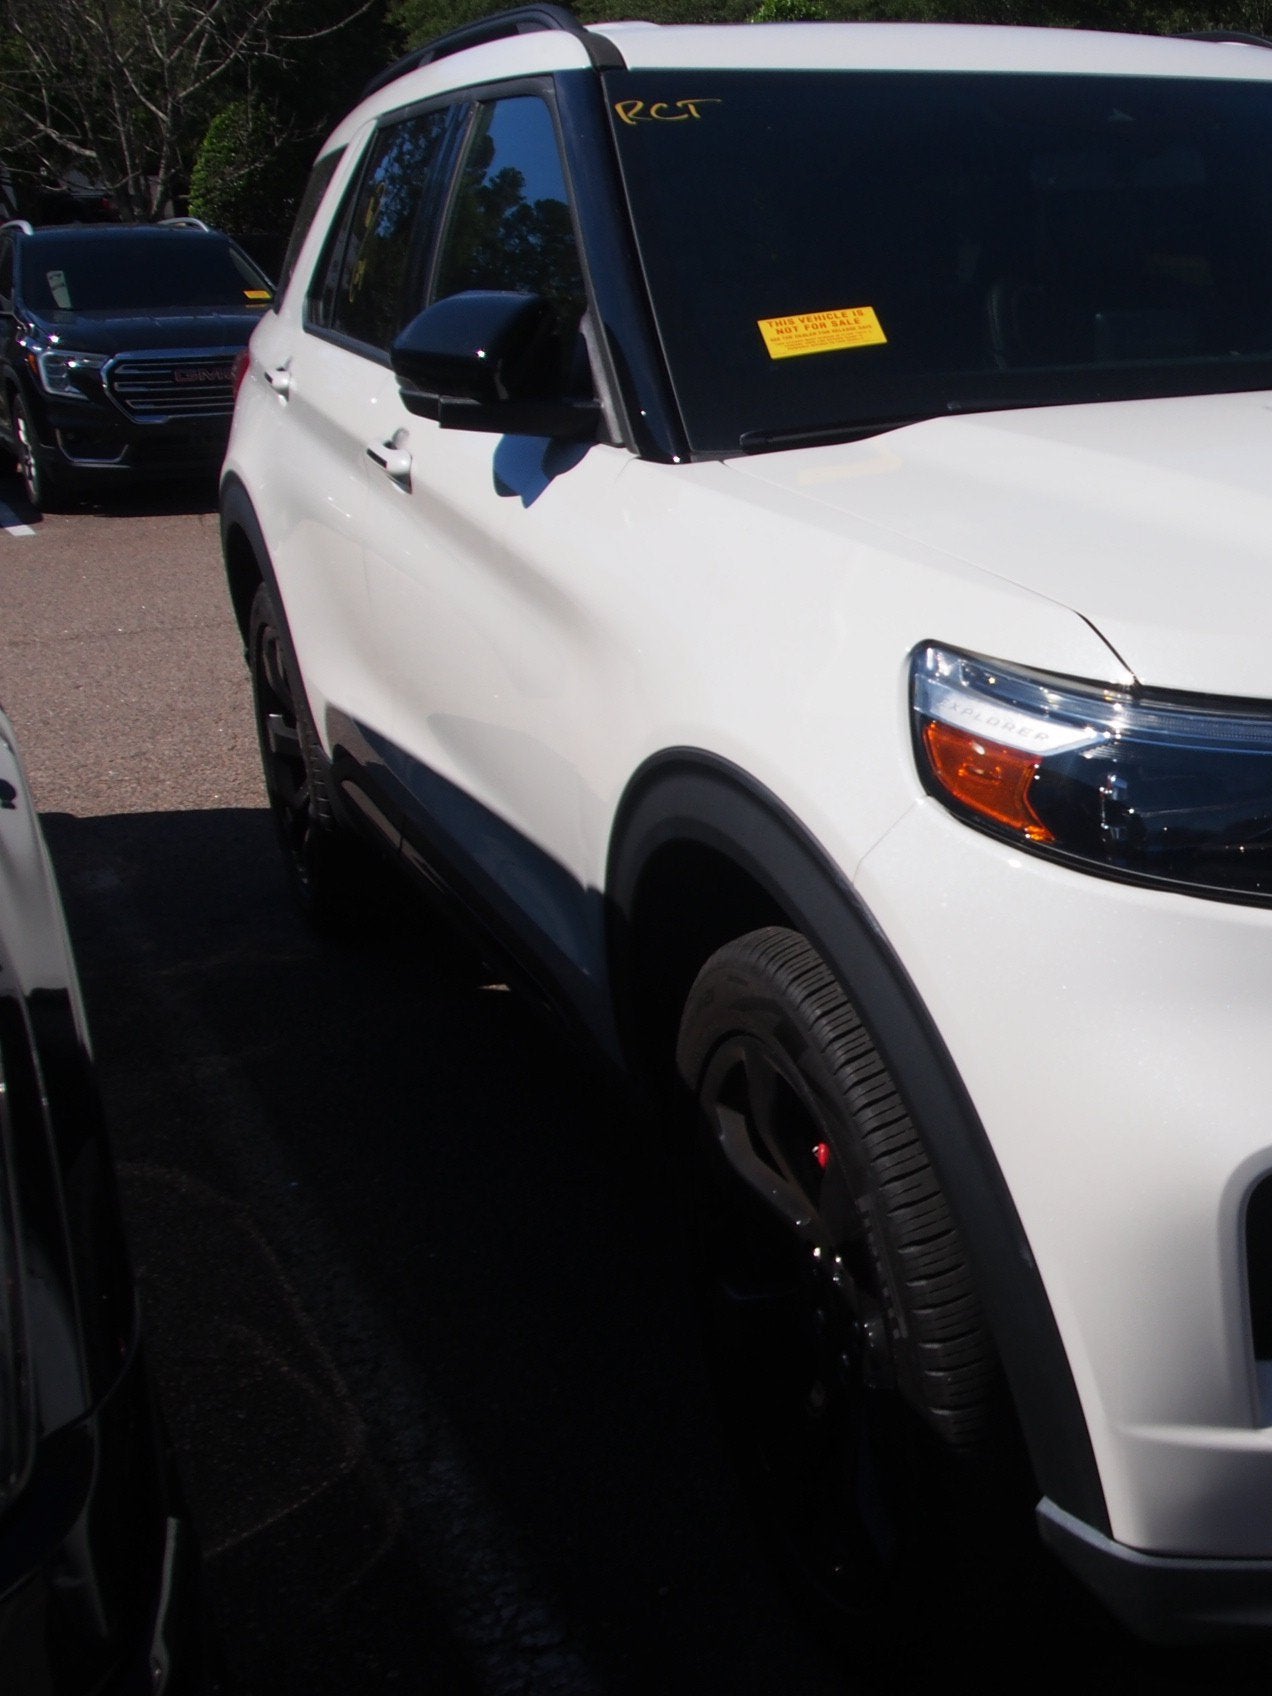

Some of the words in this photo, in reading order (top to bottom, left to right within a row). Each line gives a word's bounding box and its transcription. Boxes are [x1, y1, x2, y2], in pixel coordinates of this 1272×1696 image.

[614, 98, 722, 125] RCT
[766, 317, 795, 328] THIS
[798, 311, 848, 324] VEHICLE
[852, 308, 864, 317] IS
[776, 325, 799, 335] NOT
[804, 321, 827, 331] FOR
[831, 317, 861, 327] SALE
